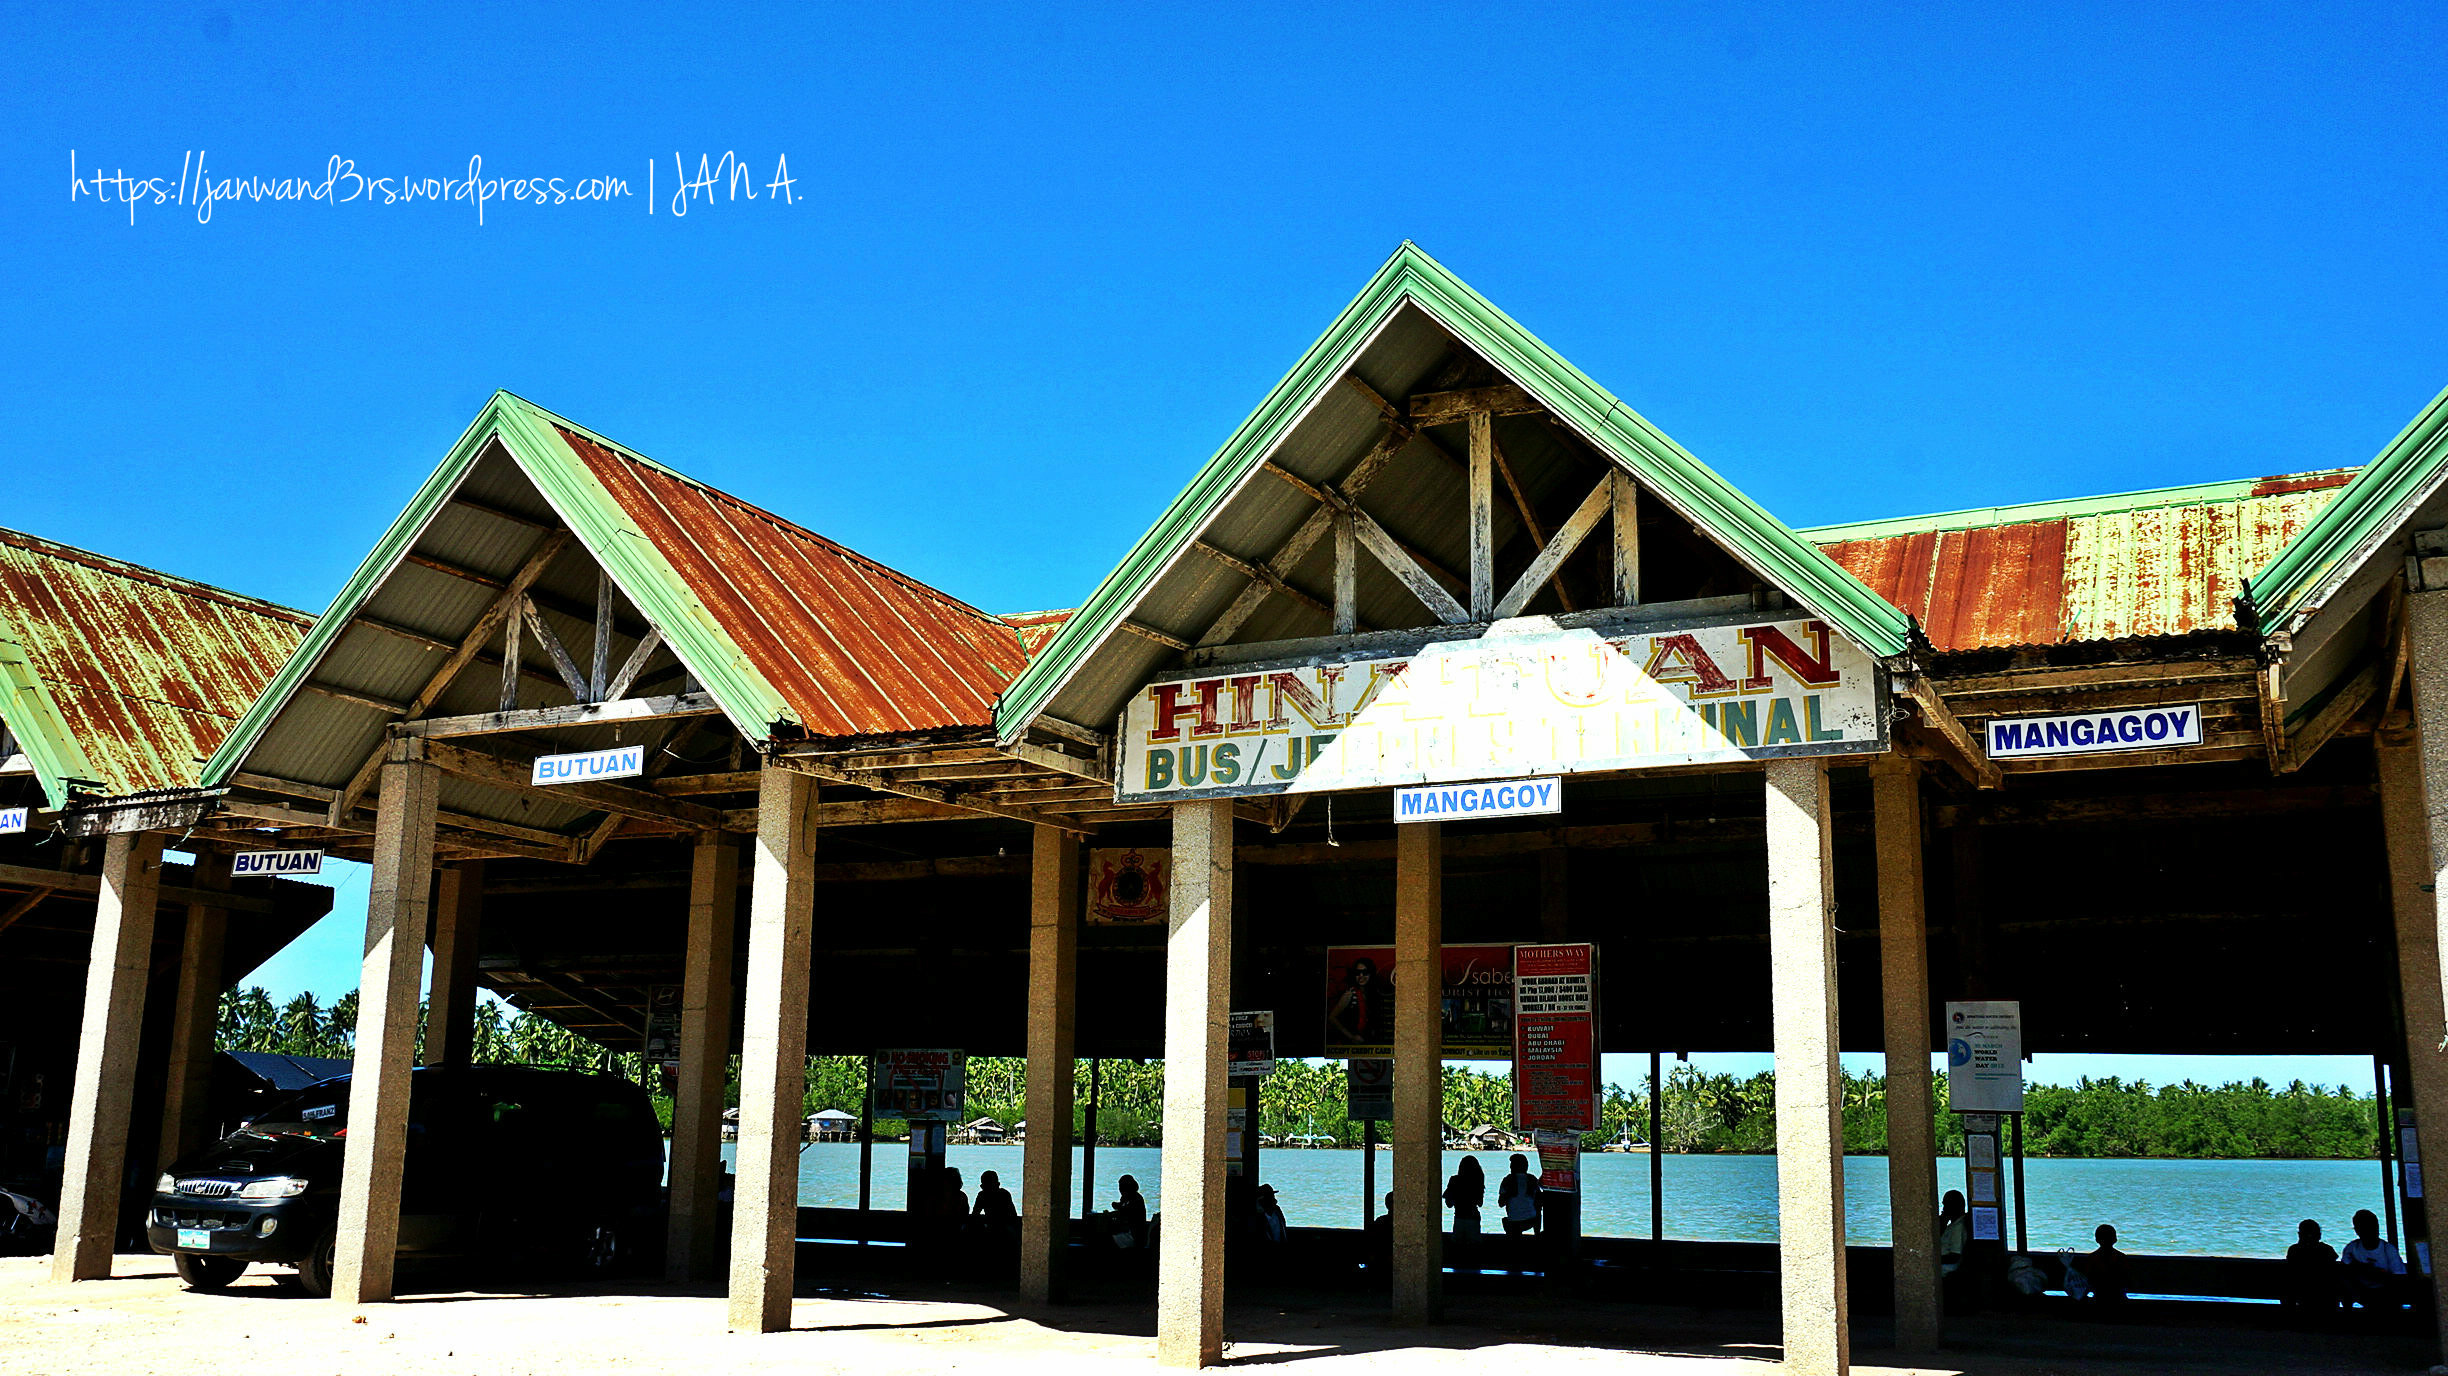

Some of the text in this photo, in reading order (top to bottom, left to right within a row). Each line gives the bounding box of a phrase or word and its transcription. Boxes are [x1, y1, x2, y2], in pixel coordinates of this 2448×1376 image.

[1994, 710, 2191, 750] MANGAGOY
[539, 753, 637, 779] BUTUAN
[1401, 783, 1552, 815] MANGAGOY
[235, 852, 319, 872] BUTUAN
